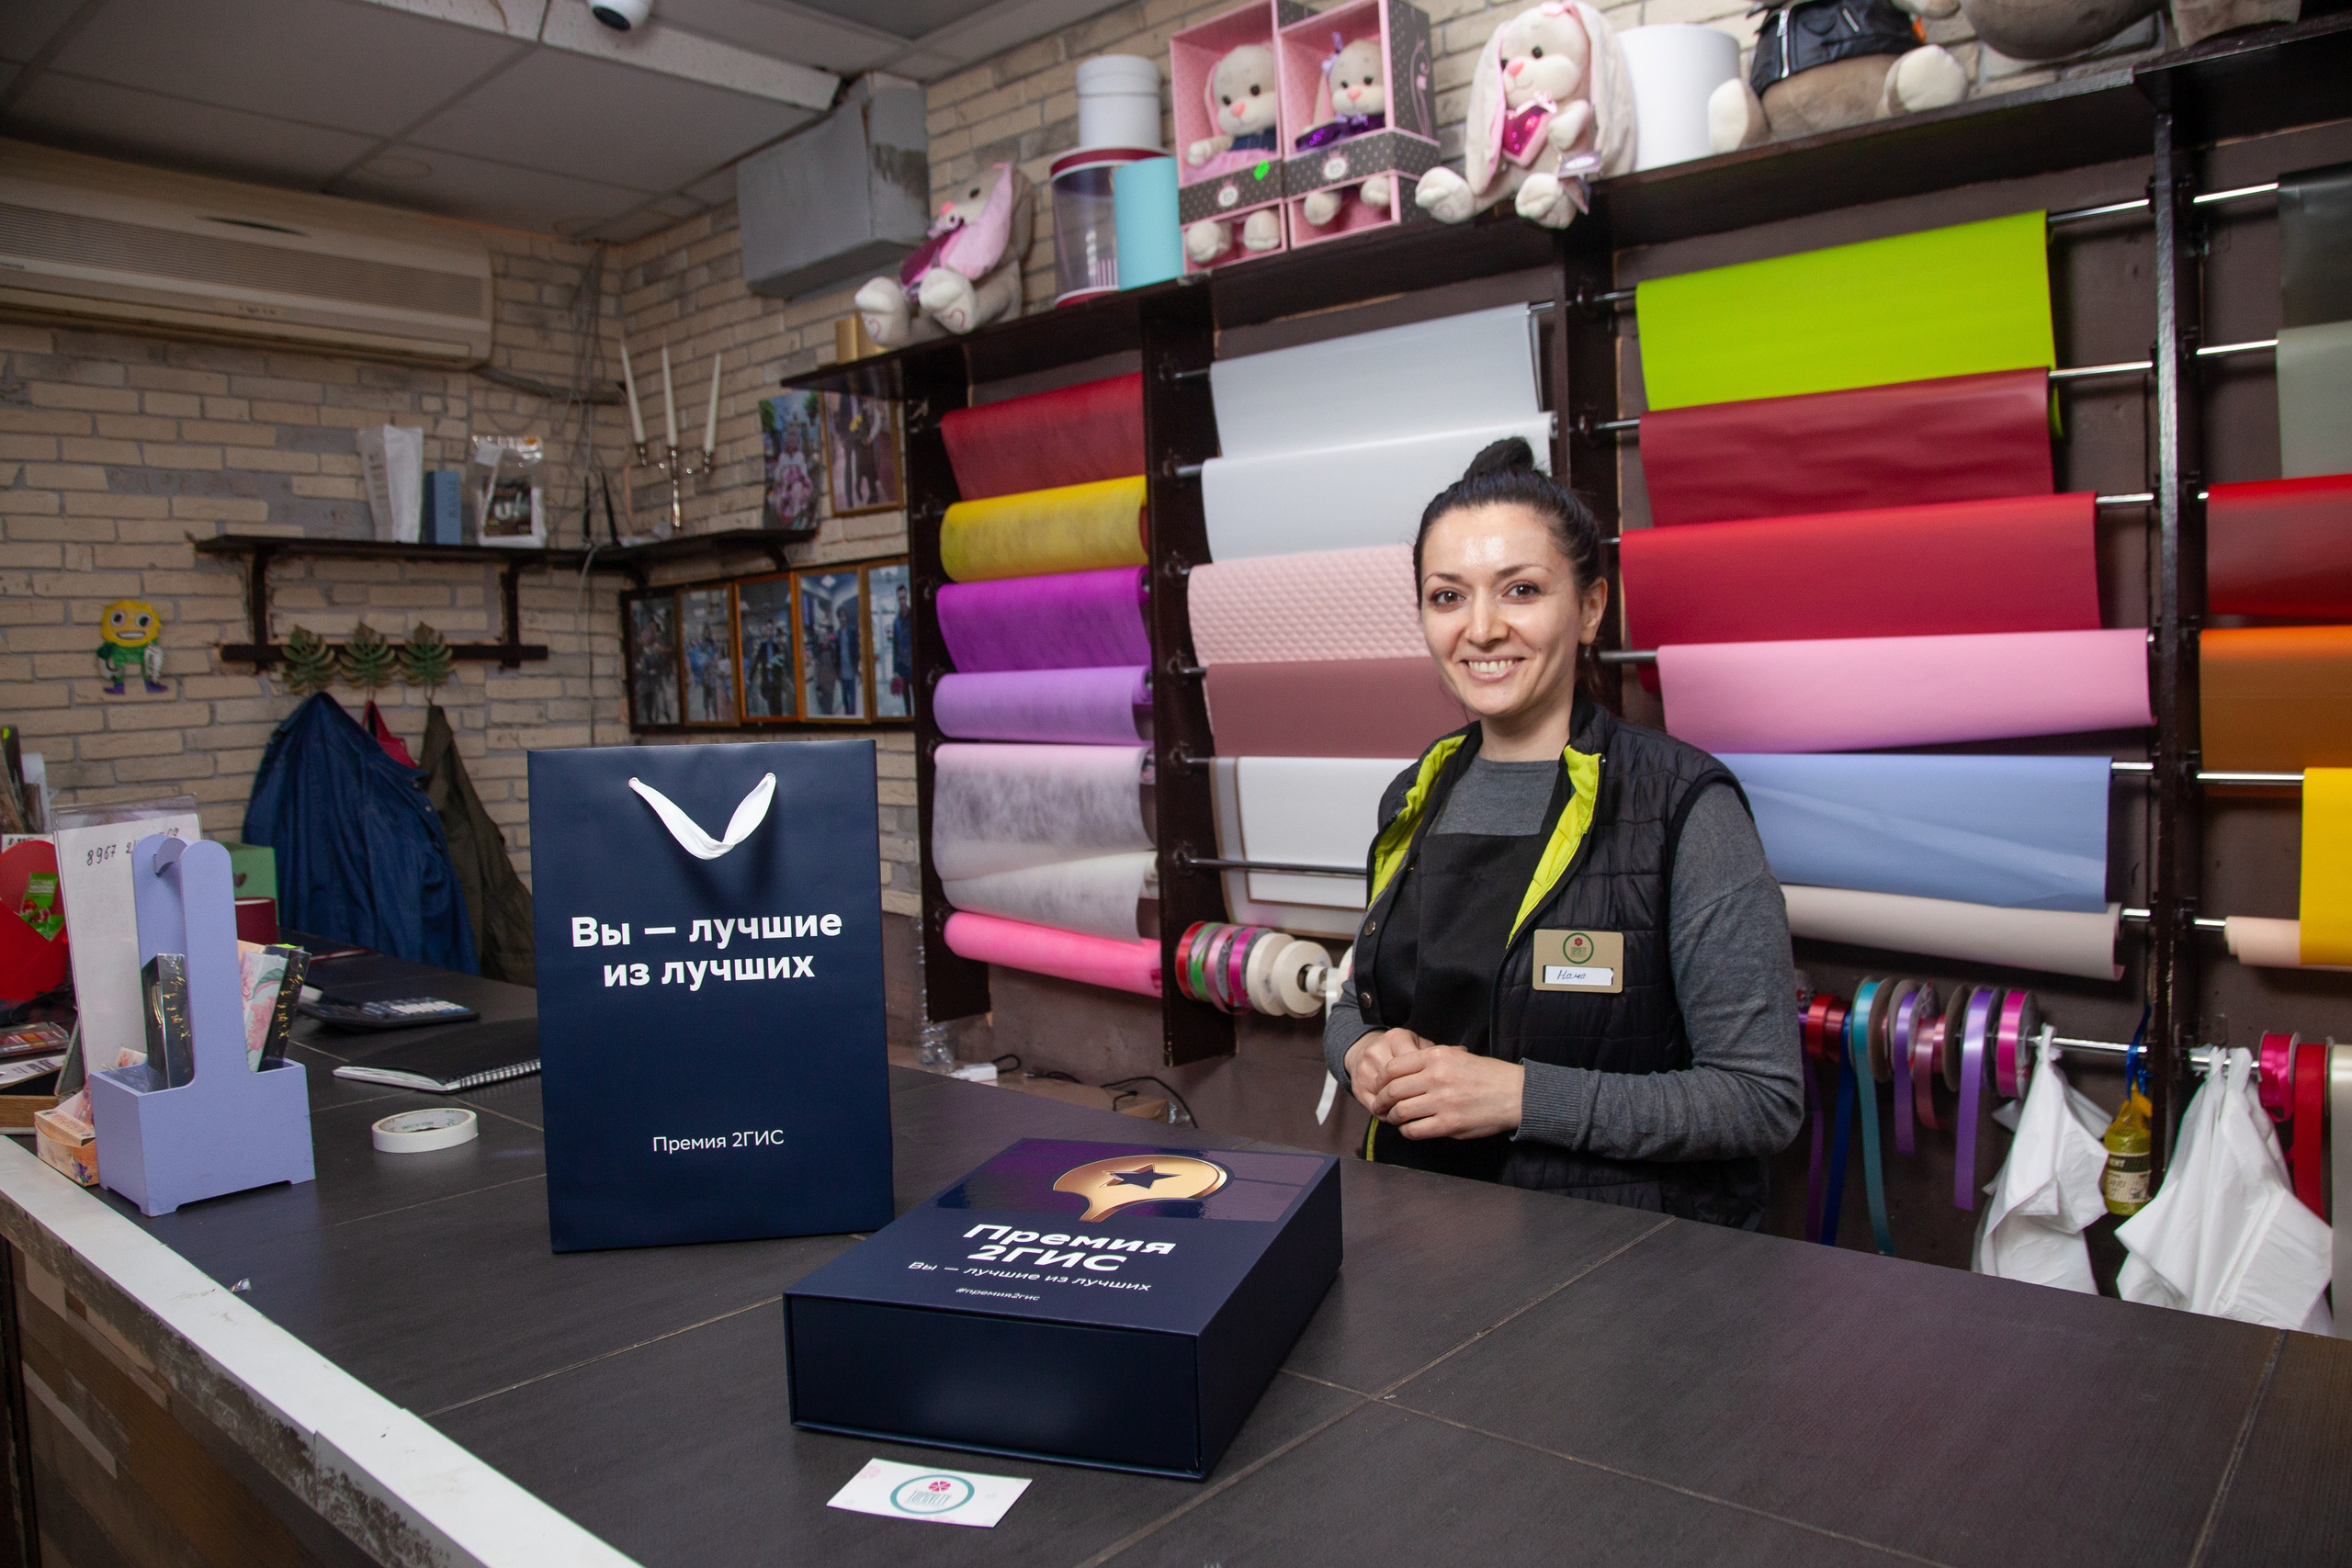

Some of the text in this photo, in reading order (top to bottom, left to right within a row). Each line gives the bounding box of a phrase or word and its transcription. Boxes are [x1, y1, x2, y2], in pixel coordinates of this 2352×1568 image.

[86, 843, 117, 866] 8967
[571, 916, 631, 947] Вы
[689, 913, 842, 950] лучшие
[604, 955, 816, 992] из лучших
[653, 1129, 785, 1155] Премия 2ГИС
[963, 1224, 1176, 1255] Премия
[967, 1245, 1127, 1272] 2ГИС
[908, 1261, 937, 1272] Вы
[963, 1267, 1040, 1281] лучшие
[1045, 1273, 1069, 1284] из
[1070, 1278, 1152, 1292] лучших
[956, 1286, 1041, 1302] #премия2гис
